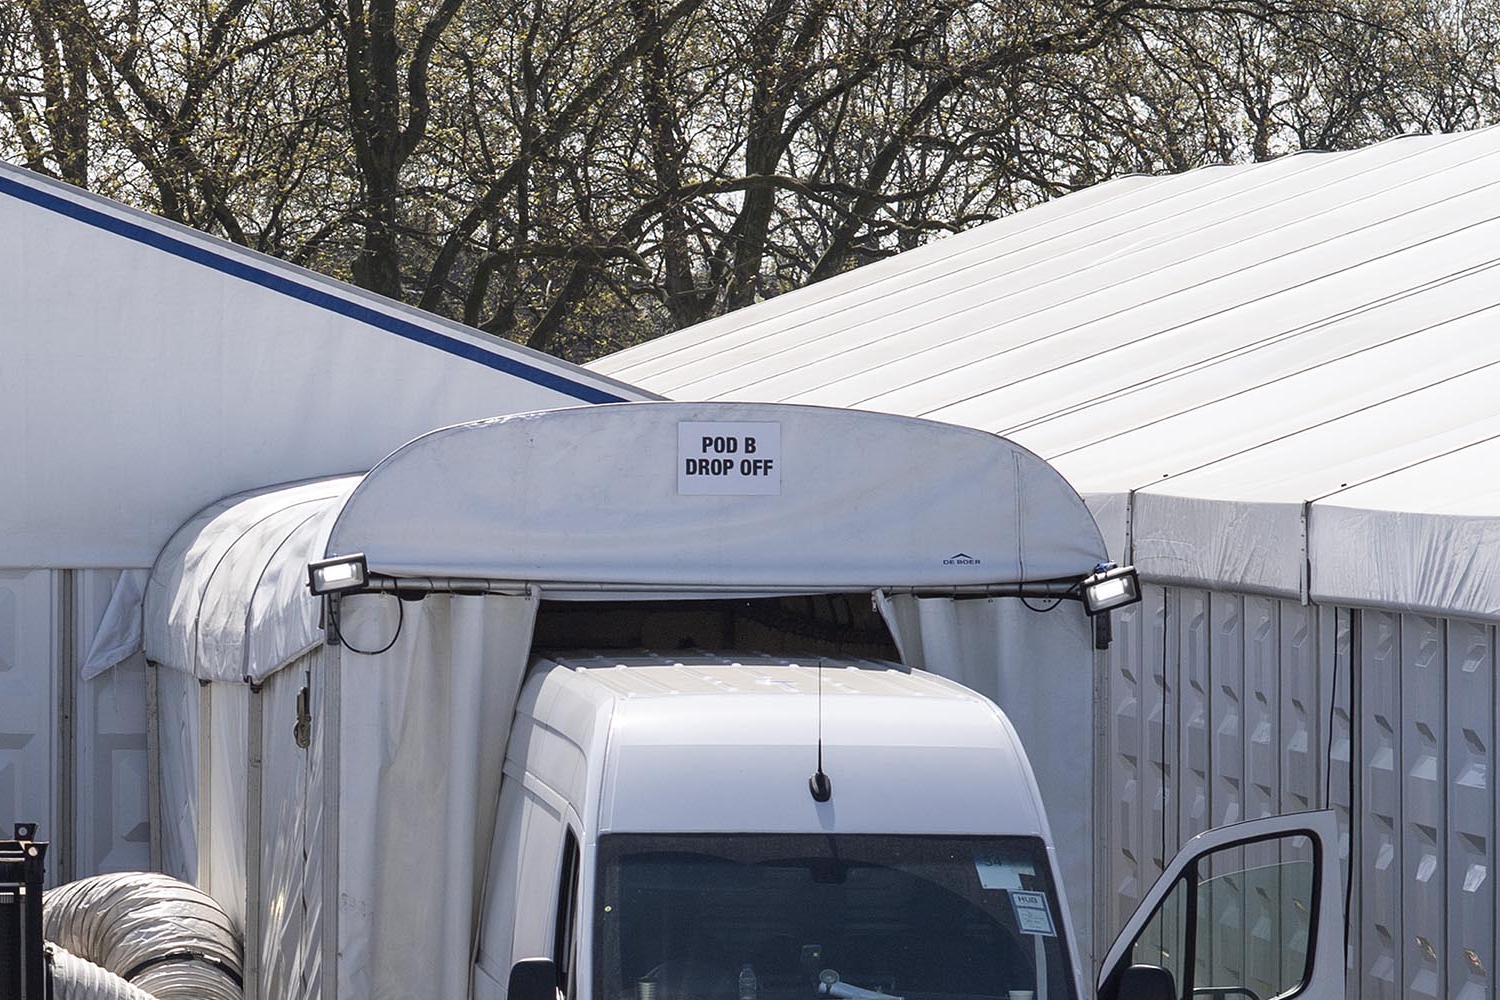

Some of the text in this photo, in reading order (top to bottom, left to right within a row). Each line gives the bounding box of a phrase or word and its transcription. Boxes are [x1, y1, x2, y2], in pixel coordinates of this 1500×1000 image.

[702, 436, 757, 454] POD B
[685, 458, 774, 476] DROP OFF
[1017, 895, 1038, 904] HUB
